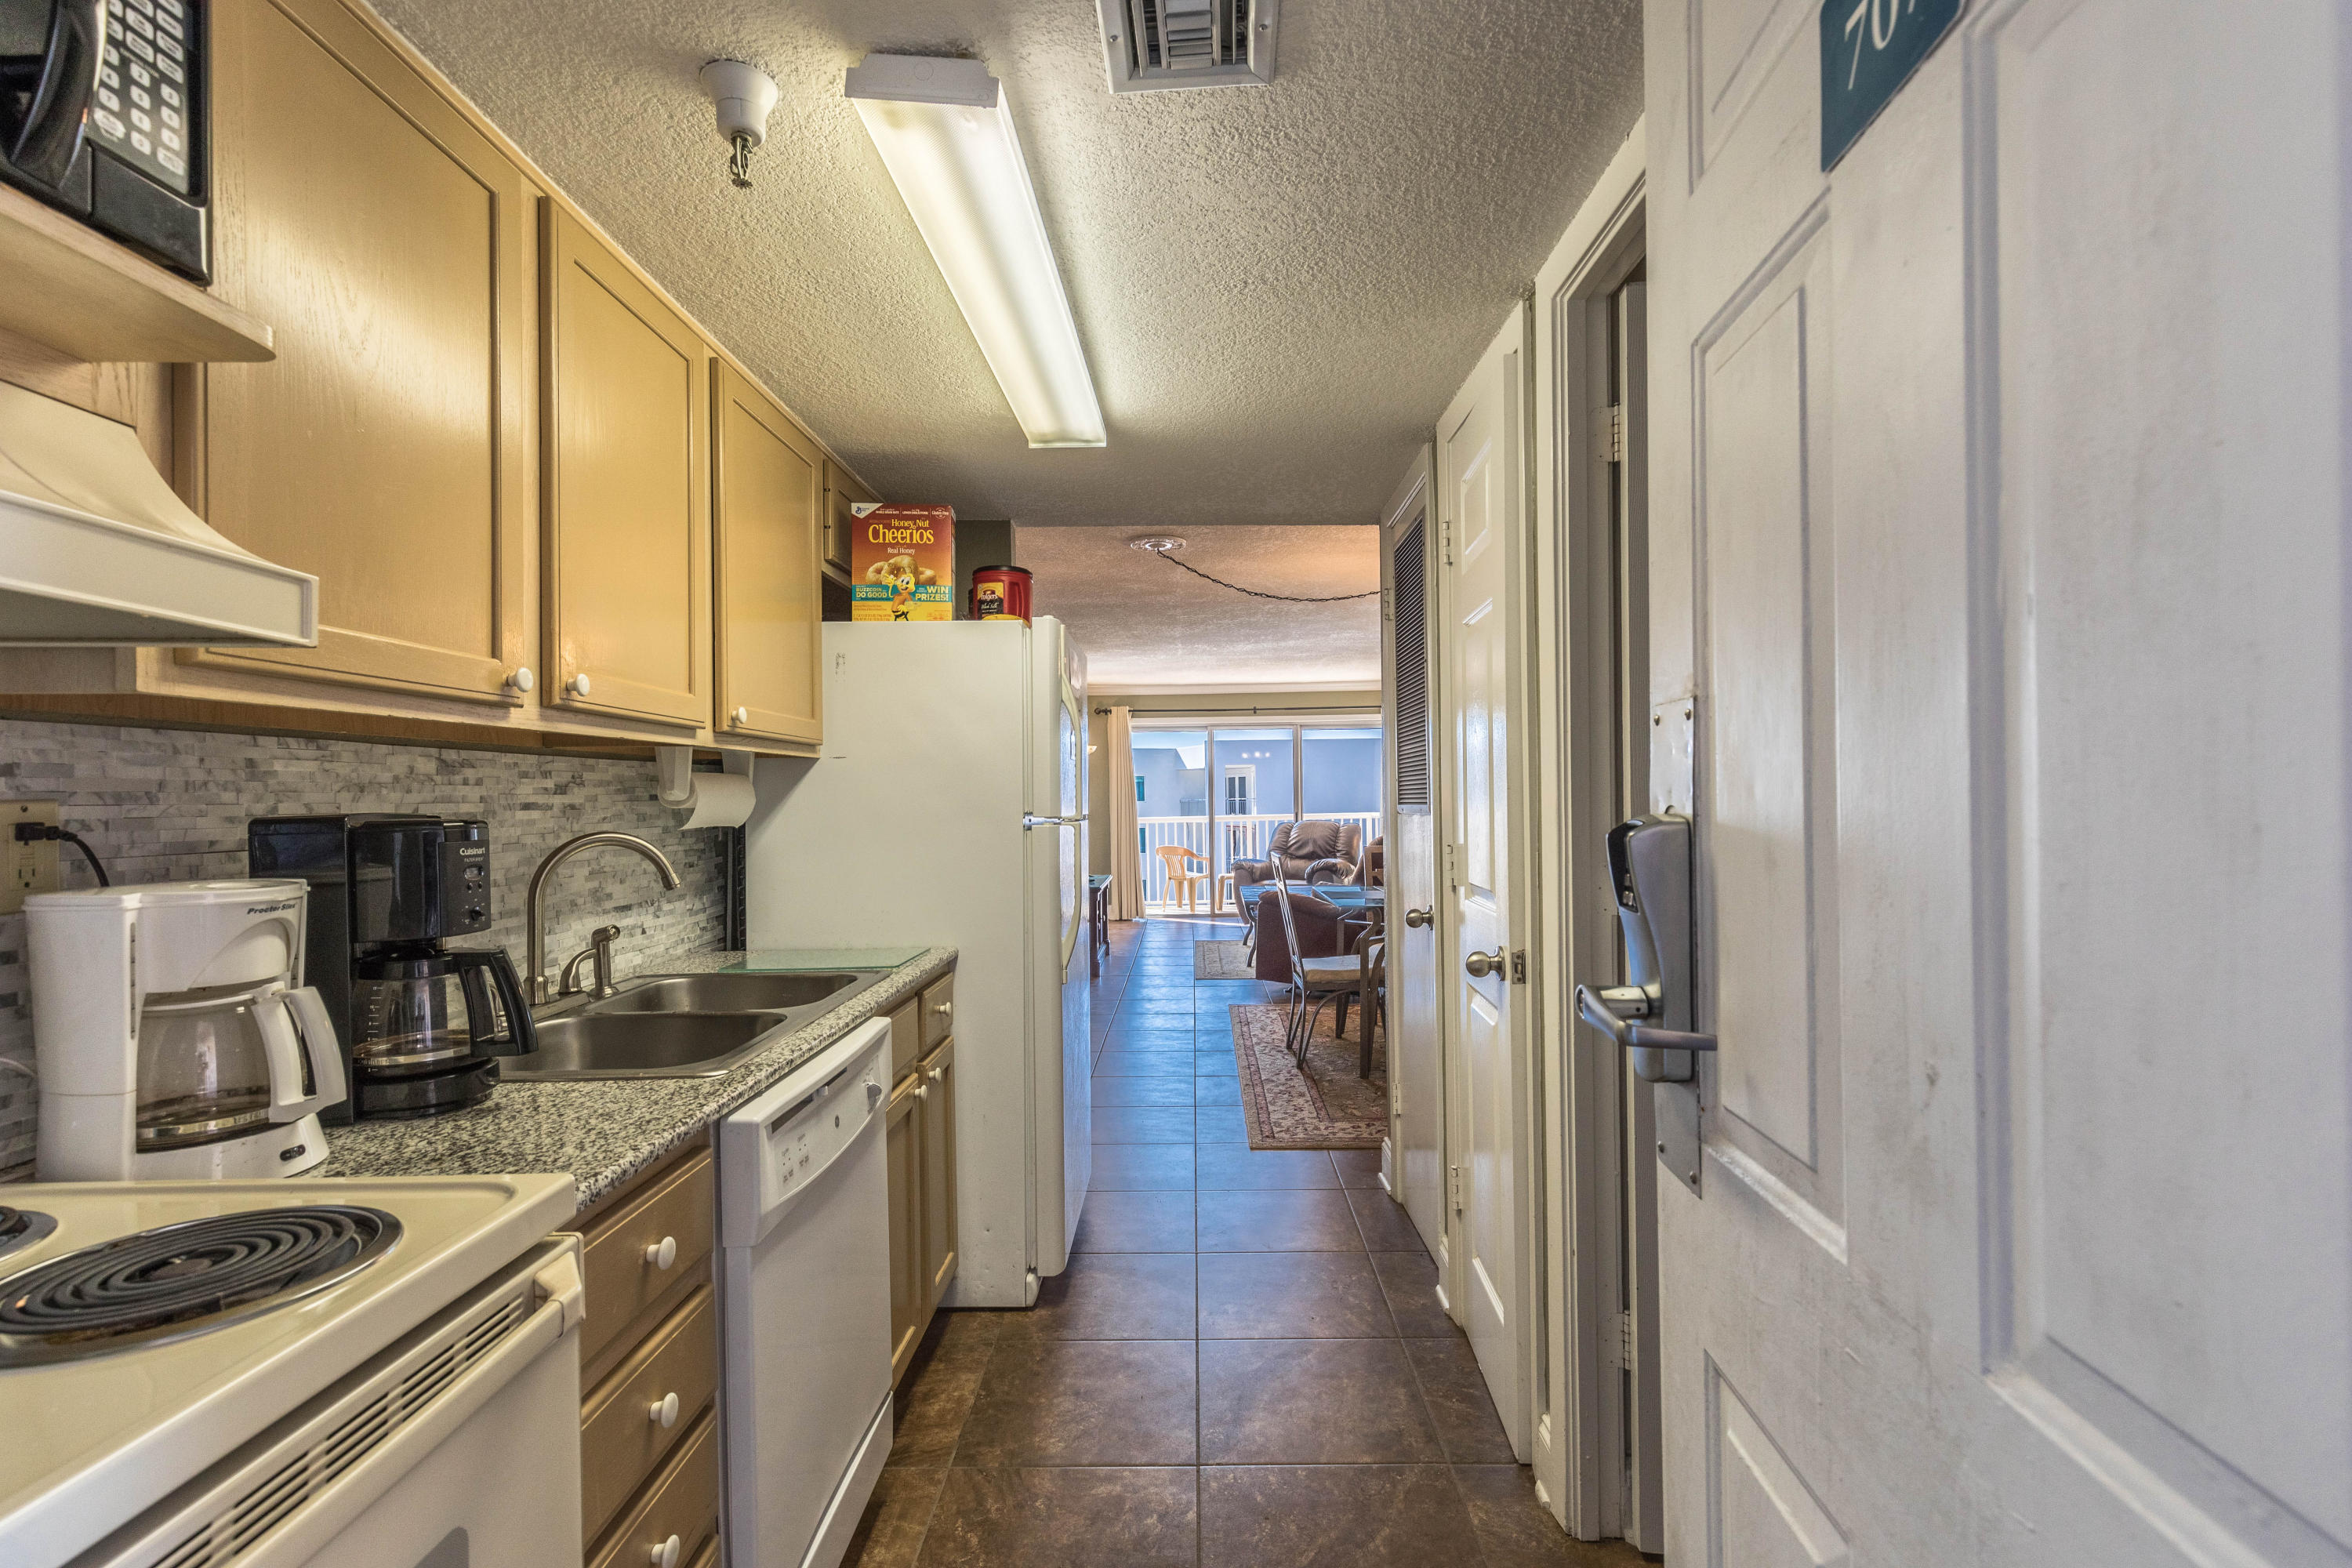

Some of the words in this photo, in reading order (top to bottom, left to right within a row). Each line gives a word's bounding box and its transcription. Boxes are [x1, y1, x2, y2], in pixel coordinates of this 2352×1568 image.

[1845, 0, 1916, 91] 70
[891, 519, 913, 528] Honey
[916, 519, 930, 528] Nut
[868, 524, 935, 544] Cheerios
